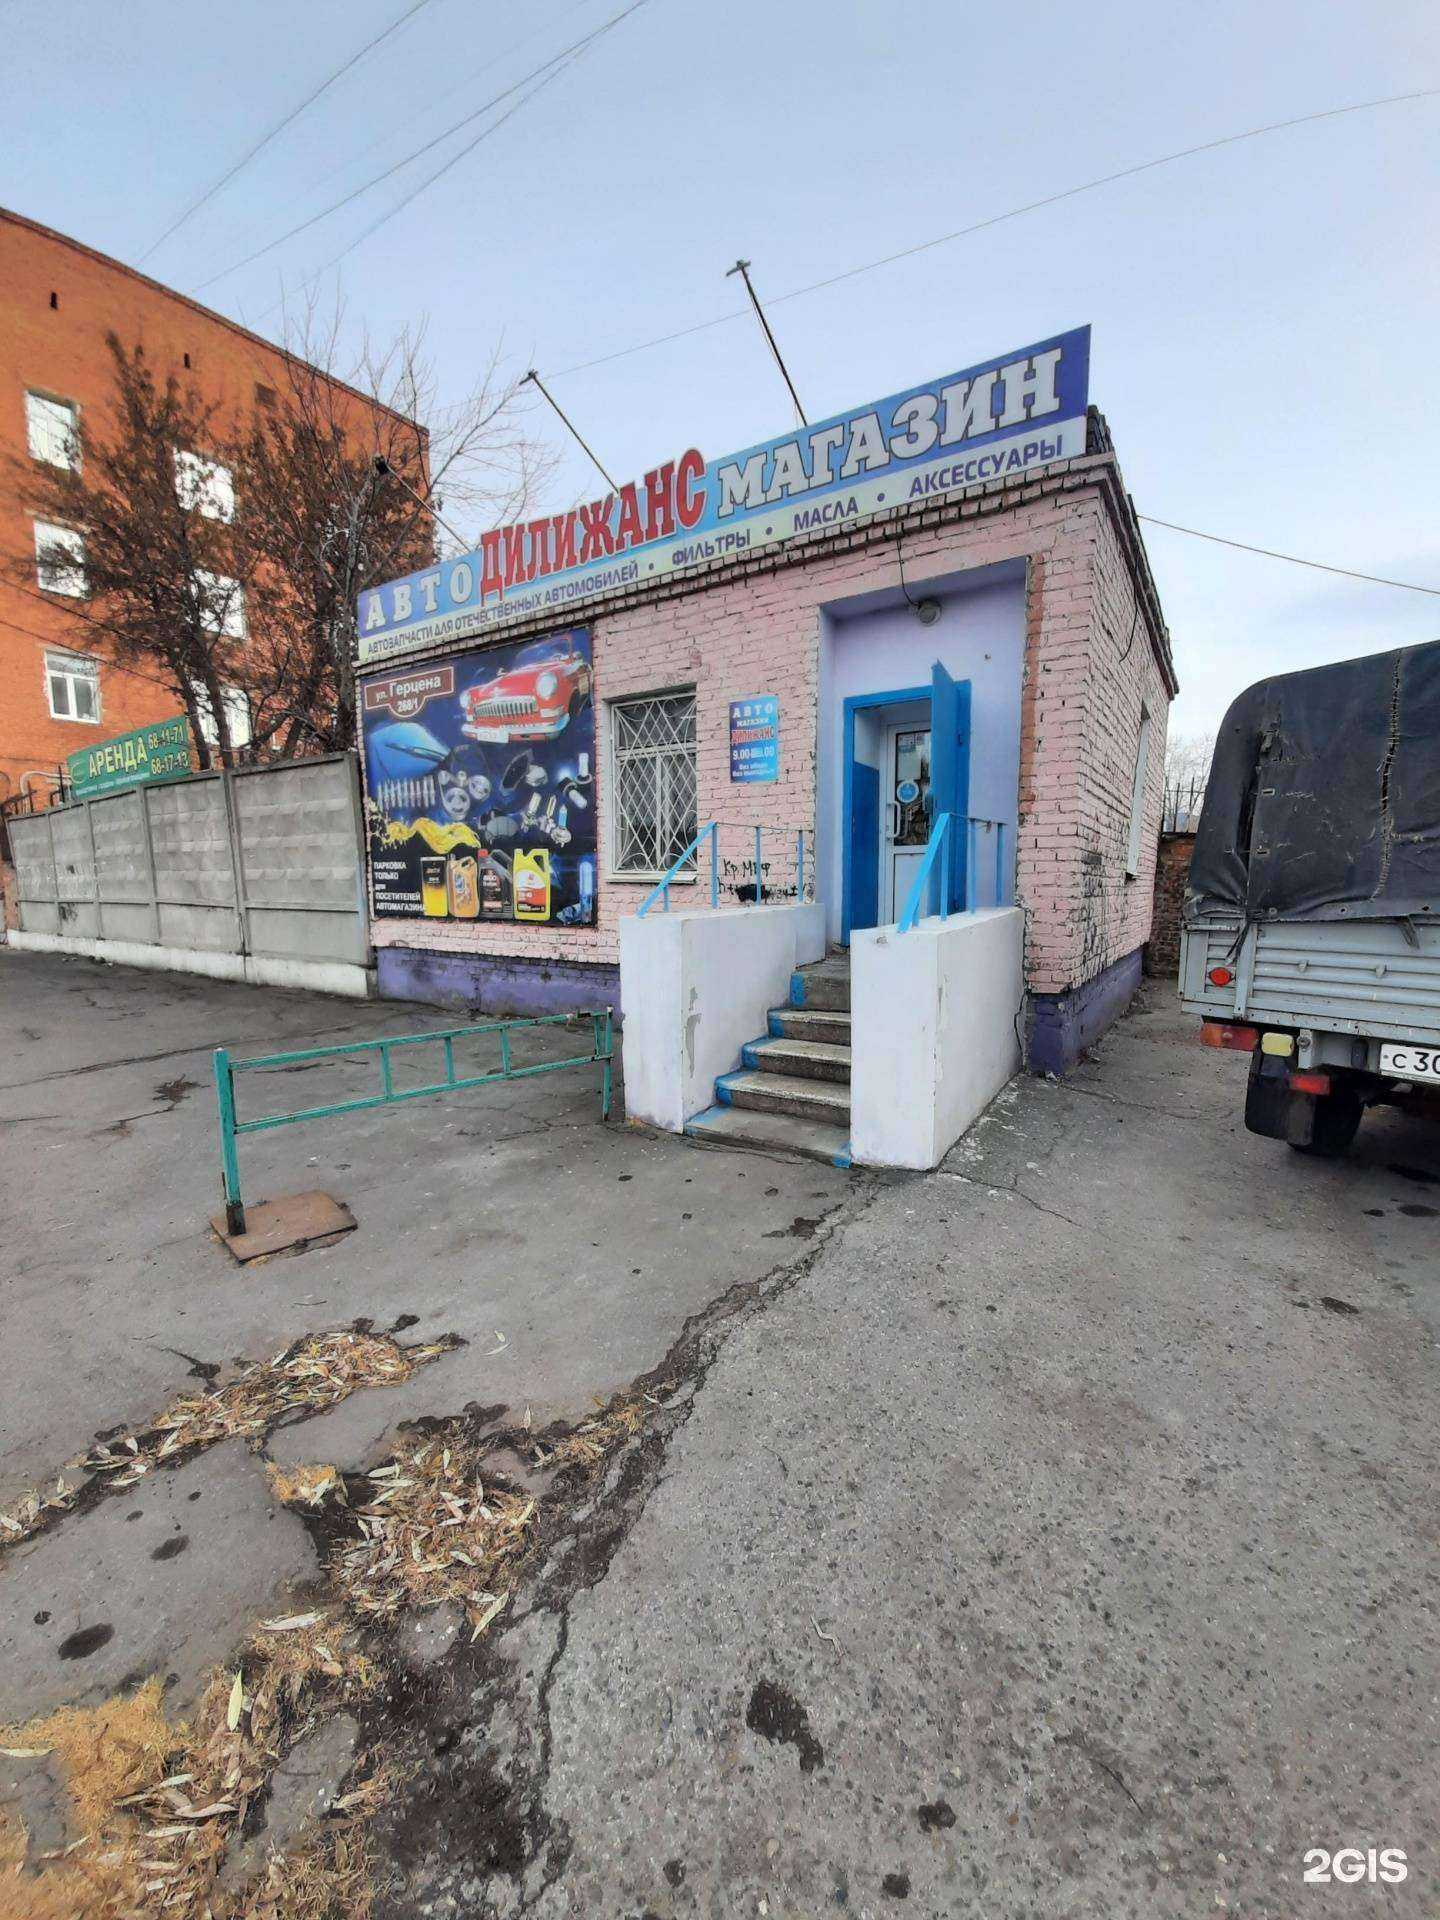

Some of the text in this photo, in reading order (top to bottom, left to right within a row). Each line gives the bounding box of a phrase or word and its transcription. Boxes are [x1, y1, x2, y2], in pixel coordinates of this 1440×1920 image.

[365, 347, 1062, 631] АВТО ДИЛИЖАНС МАГАЗИН
[368, 435, 1062, 654] АВТОЗАПЧАСТИ ДЛЯ ОТЕЧЕСТВЕННЫХ АВТОМОБИЛЕЙ ФИЛЬТРЫ МАСЛА АКСЕССУАРЫ
[389, 676, 441, 699] Герцена
[88, 736, 148, 778] АРЕНДА
[373, 861, 407, 870] ПАРКОВКА
[374, 872, 399, 880] ТОЛЬКО
[375, 891, 421, 901] ПОСЕТИТЕЛЕЙ
